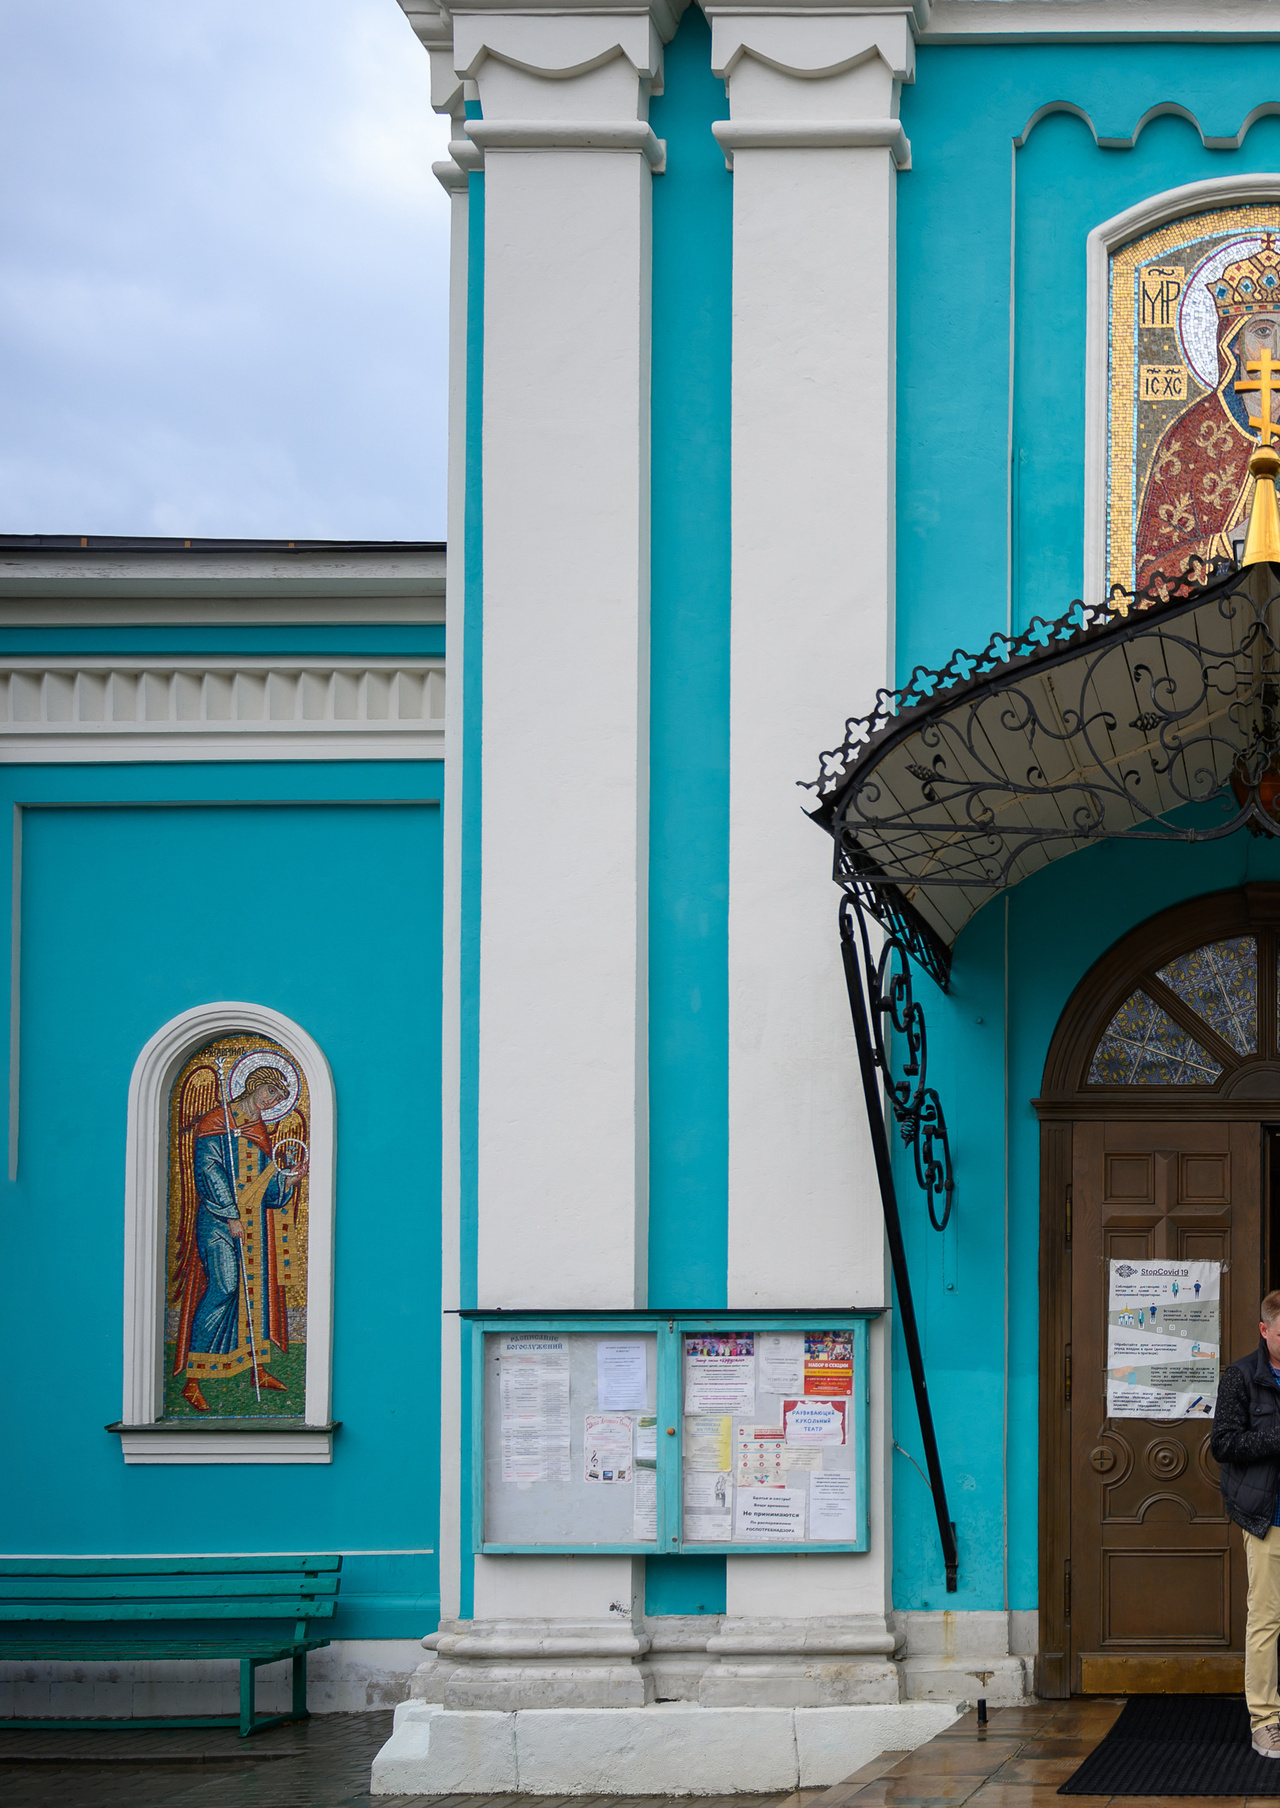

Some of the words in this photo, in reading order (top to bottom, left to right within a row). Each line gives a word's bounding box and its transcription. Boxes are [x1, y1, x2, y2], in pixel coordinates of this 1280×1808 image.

[1141, 1268, 1179, 1277] StopCovid
[510, 1334, 559, 1342] РАСПИСАНИЕ
[506, 1343, 563, 1351] БОГОСЛУЖЕНИЙ
[791, 1409, 836, 1417] РАЗВИВАЮЩИЙ
